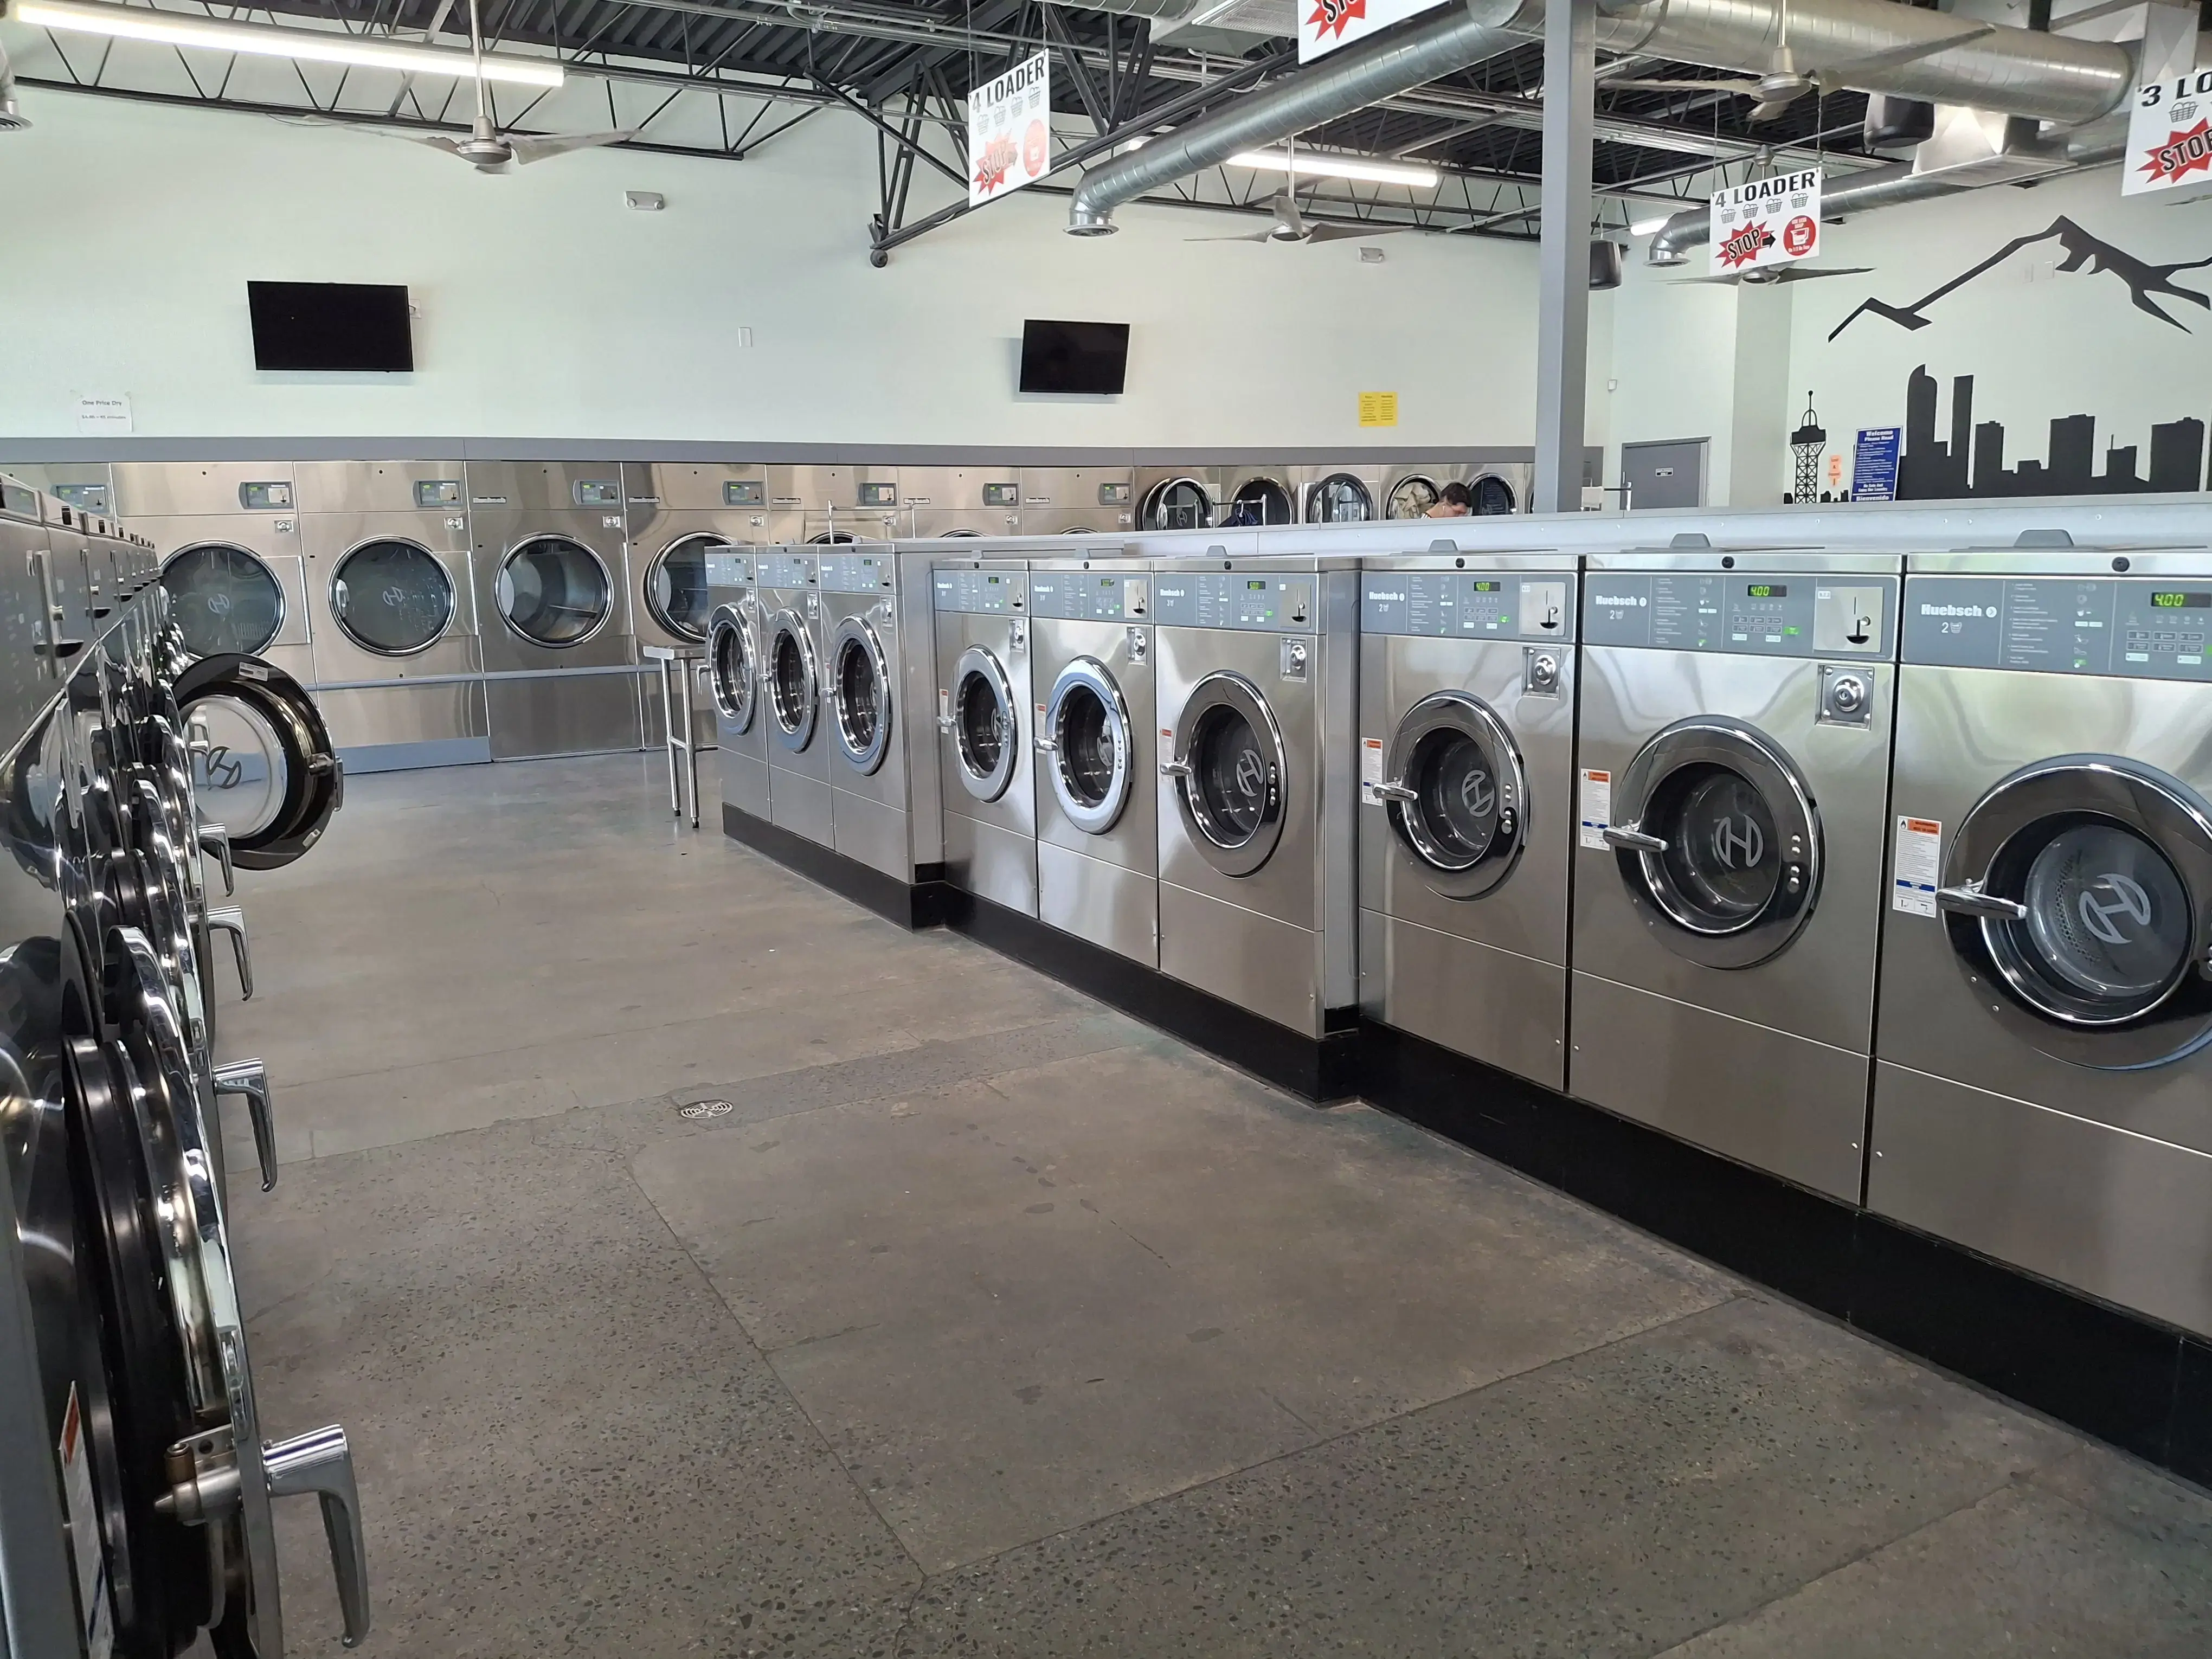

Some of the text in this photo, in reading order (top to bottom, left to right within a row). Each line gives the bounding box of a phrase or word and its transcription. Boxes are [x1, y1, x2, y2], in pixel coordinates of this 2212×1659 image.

[973, 56, 1044, 113] 4 LOADER
[2142, 85, 2162, 107] 3
[982, 140, 1009, 185] STOP
[1715, 171, 1815, 208] 4 LOADER
[1727, 229, 1760, 259] STOP
[1369, 591, 1398, 601] Huebsch
[1595, 595, 1637, 606] Huebsch
[1379, 603, 1383, 612] 2
[1921, 604, 1983, 617] Huebsch
[1609, 609, 1615, 620] 2
[1941, 622, 1949, 633] 2
